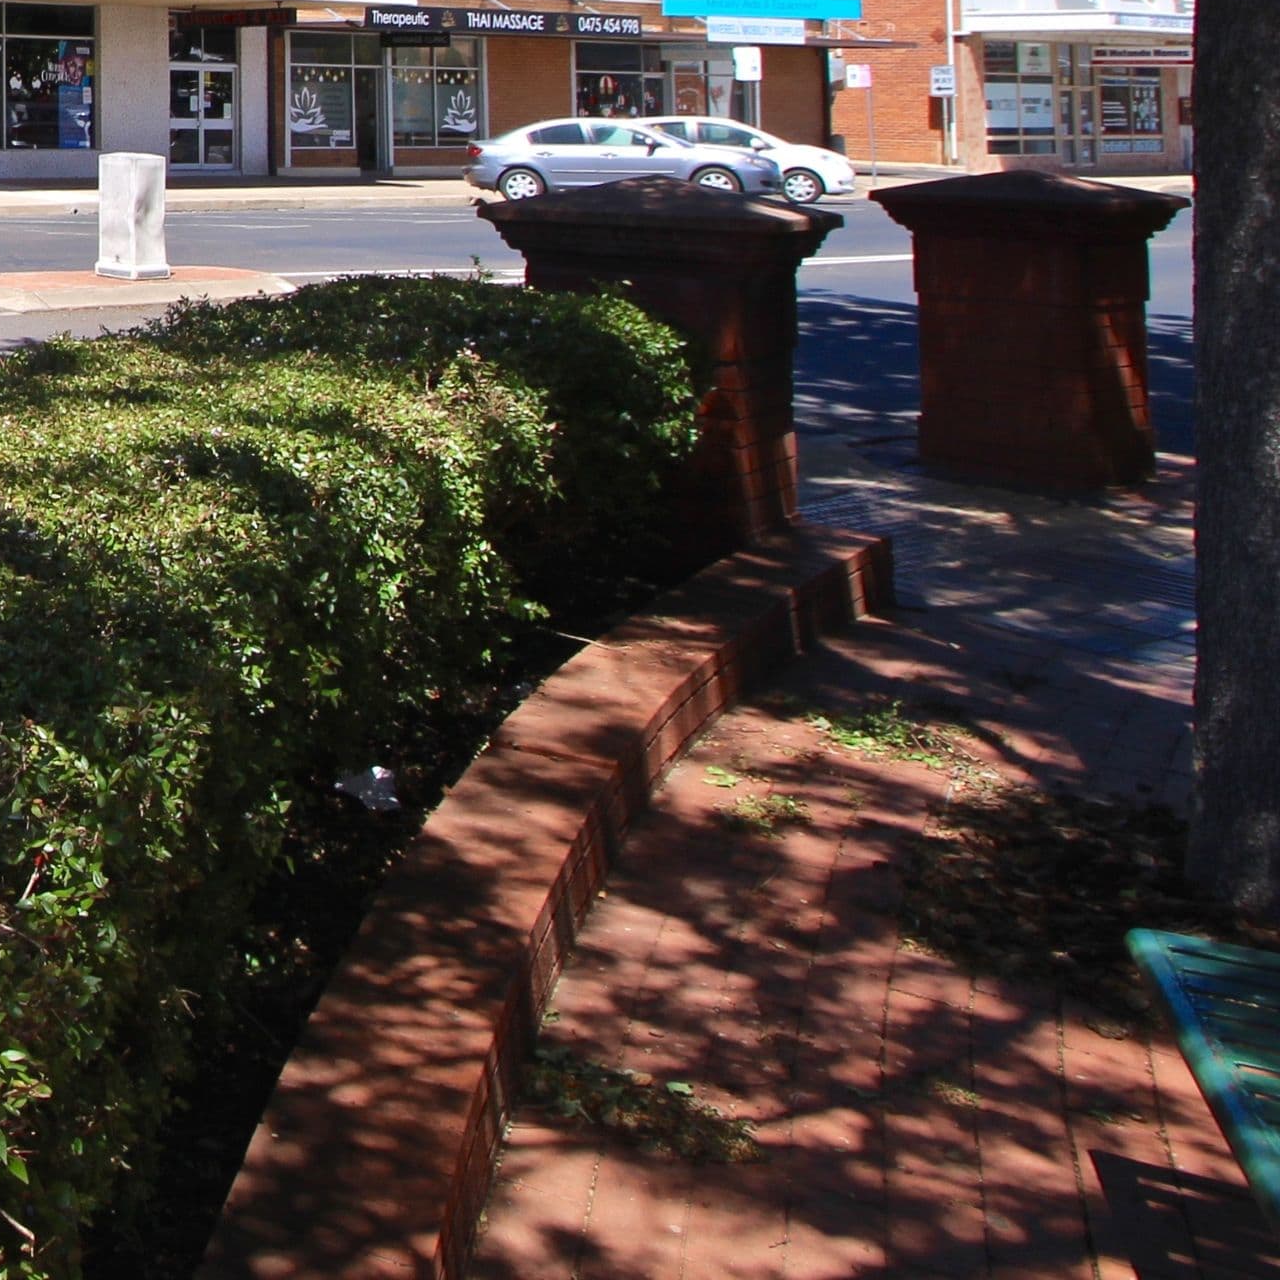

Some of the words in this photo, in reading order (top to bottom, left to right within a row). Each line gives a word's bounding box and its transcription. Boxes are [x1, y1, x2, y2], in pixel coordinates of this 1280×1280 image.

[371, 10, 429, 26] Therapeutic
[467, 12, 492, 28] THAI
[492, 13, 544, 31] MASSAGE
[578, 16, 601, 33] 0475
[602, 17, 621, 34] 454
[621, 18, 639, 35] 998
